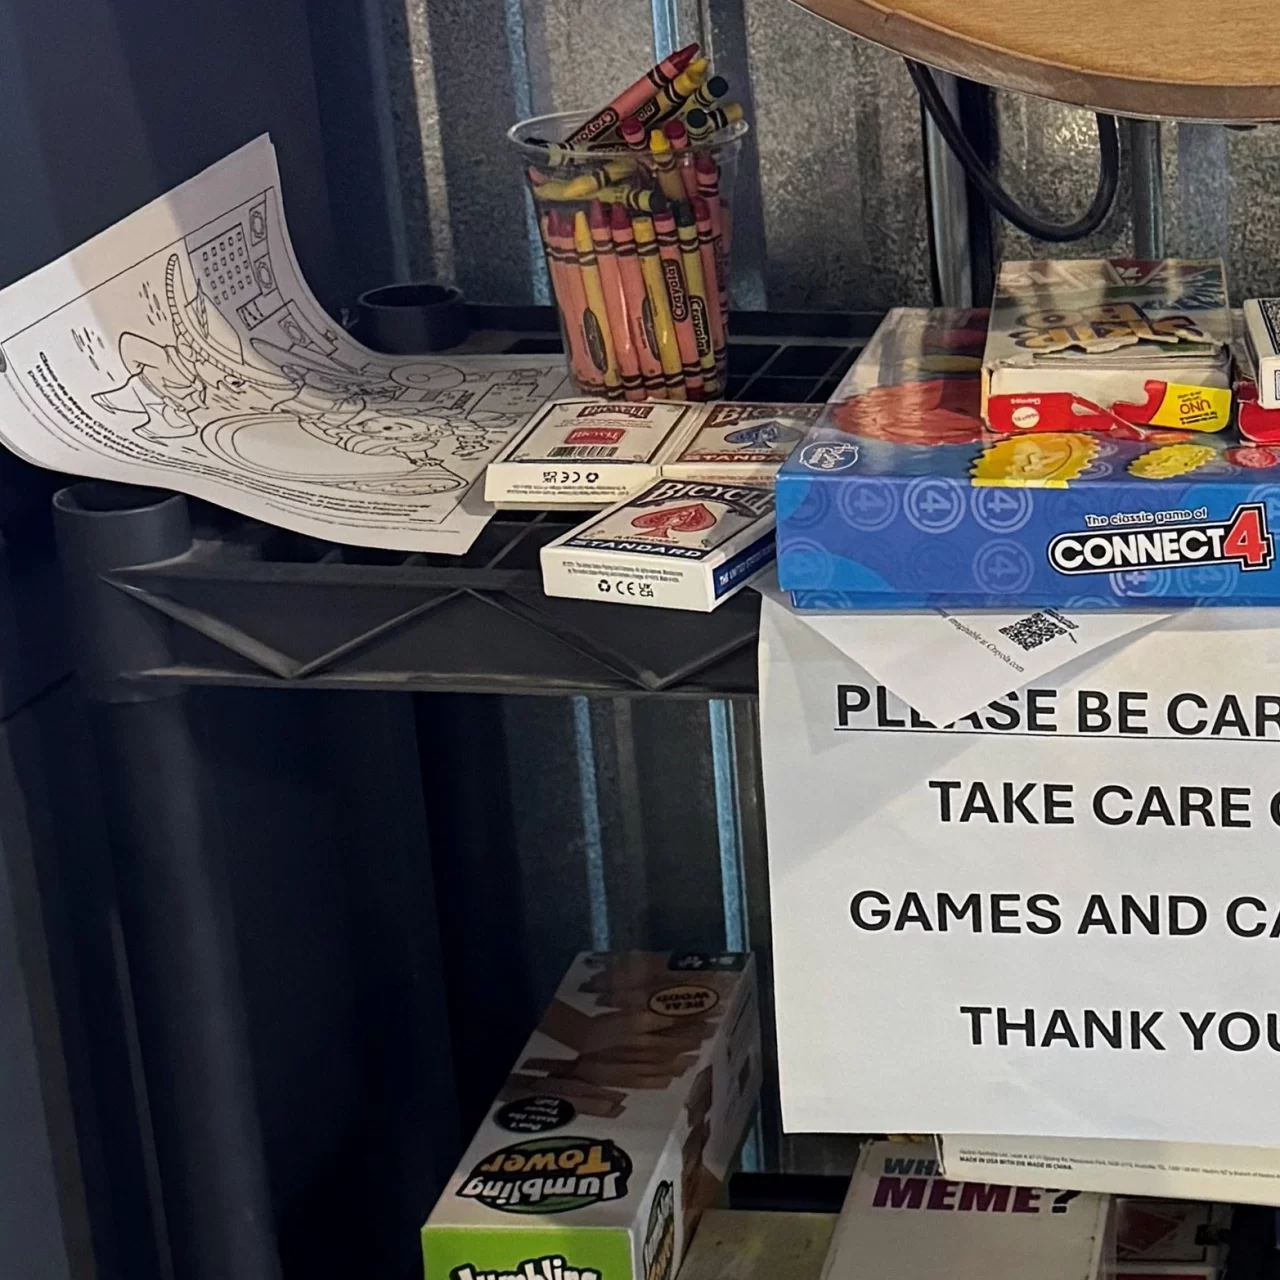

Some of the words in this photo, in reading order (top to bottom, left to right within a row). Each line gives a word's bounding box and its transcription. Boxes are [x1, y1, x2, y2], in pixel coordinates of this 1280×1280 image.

[577, 404, 653, 418] BICYCLE
[1178, 399, 1213, 414] UNO
[637, 482, 776, 517] BICYCLE
[1085, 515, 1107, 527] The
[1111, 512, 1152, 525] classic
[1155, 510, 1192, 524] game
[1193, 507, 1207, 520] of
[569, 540, 701, 559] STANDARD
[1053, 529, 1225, 568] CONNECT
[837, 684, 1058, 732] PLSE
[1078, 691, 1149, 736] BE
[928, 780, 1074, 825] TAKE
[1092, 784, 1252, 828] CARE
[849, 891, 1061, 936] GAMES
[1077, 894, 1208, 937] AND
[959, 1006, 1167, 1051] THANK
[481, 1146, 612, 1175] Tower
[463, 1172, 621, 1205] Jumbling
[872, 1175, 1083, 1215] MEME?
